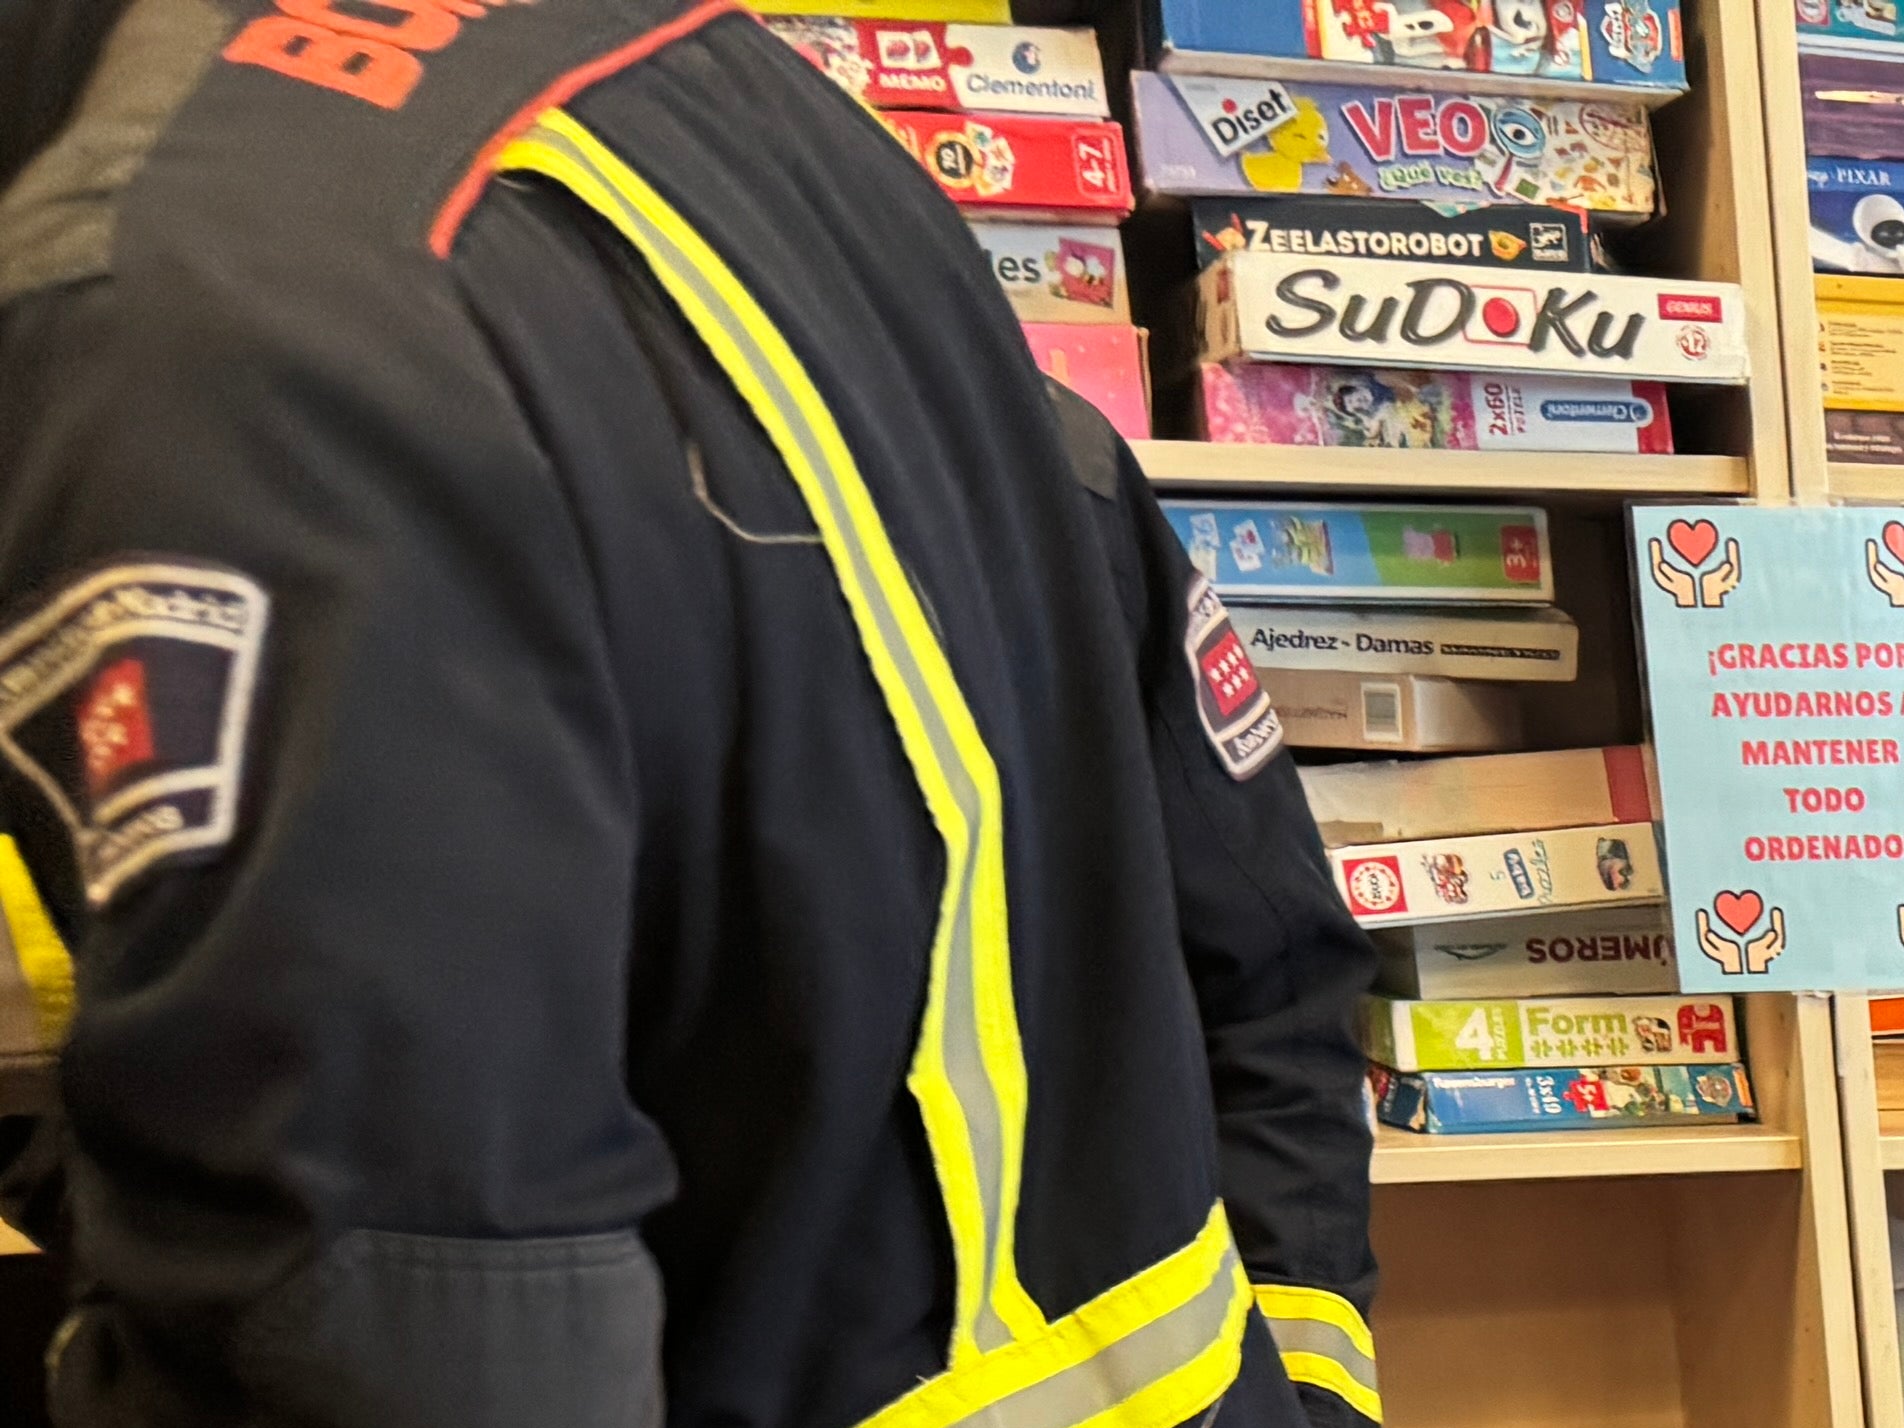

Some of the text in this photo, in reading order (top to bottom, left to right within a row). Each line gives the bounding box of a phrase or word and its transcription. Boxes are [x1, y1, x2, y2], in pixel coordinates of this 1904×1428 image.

[880, 72, 947, 92] MEMO
[968, 73, 1098, 101] Clementoni
[1211, 89, 1290, 147] Diset
[1344, 95, 1488, 161] VEO
[1836, 166, 1892, 186] PIXAR
[1246, 219, 1485, 258] ZEELASTOROBOT
[1484, 383, 1509, 436] 2x60
[1250, 629, 1337, 654] Ajedrez
[1356, 633, 1434, 656] Damas
[1707, 642, 1848, 675] ¡GRACIAS
[1711, 691, 1894, 718] AYUDARNOS
[1741, 738, 1900, 766] MANTENER
[1783, 787, 1866, 814] TODO
[1454, 1007, 1495, 1061] 4
[1525, 1006, 1627, 1037] Form
